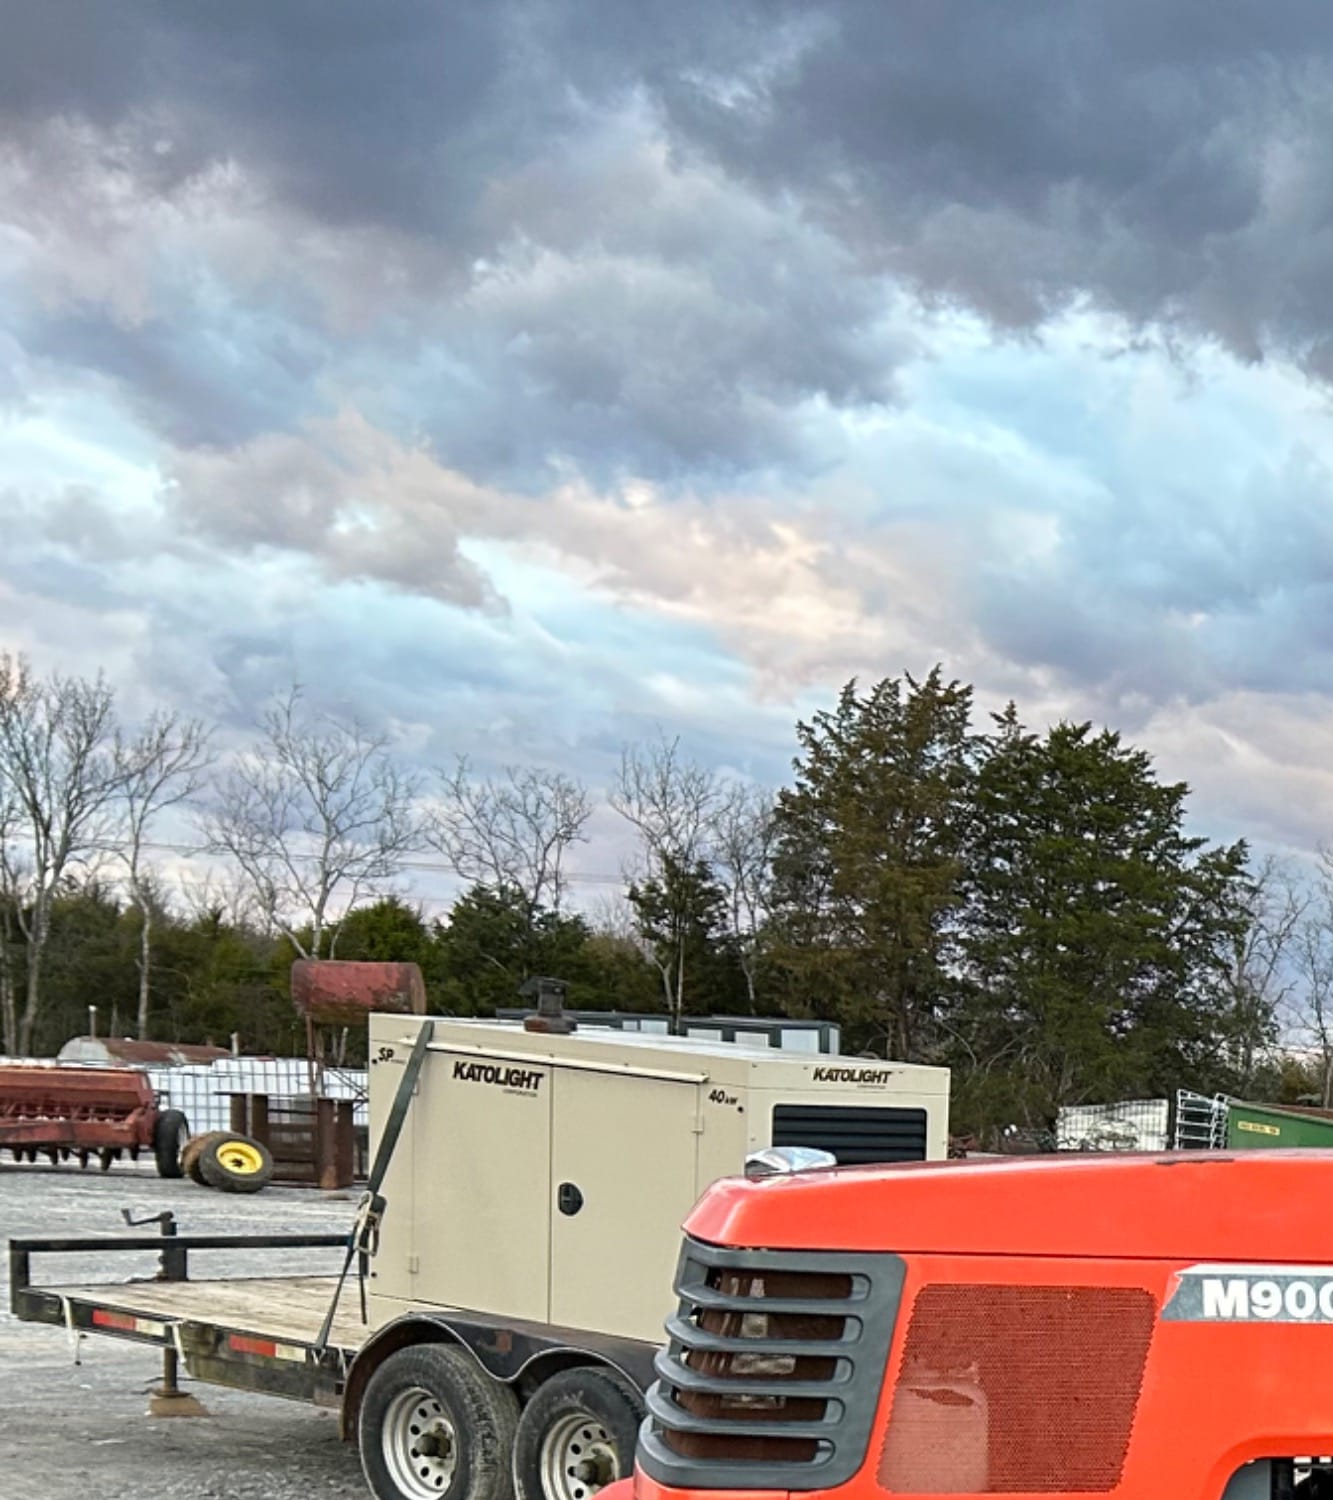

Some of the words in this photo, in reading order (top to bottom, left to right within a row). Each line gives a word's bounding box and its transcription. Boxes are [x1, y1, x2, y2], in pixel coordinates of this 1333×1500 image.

[453, 1060, 544, 1091] KATOLIGHT
[812, 1067, 892, 1084] KATOLIGHT
[709, 1089, 725, 1104] 40
